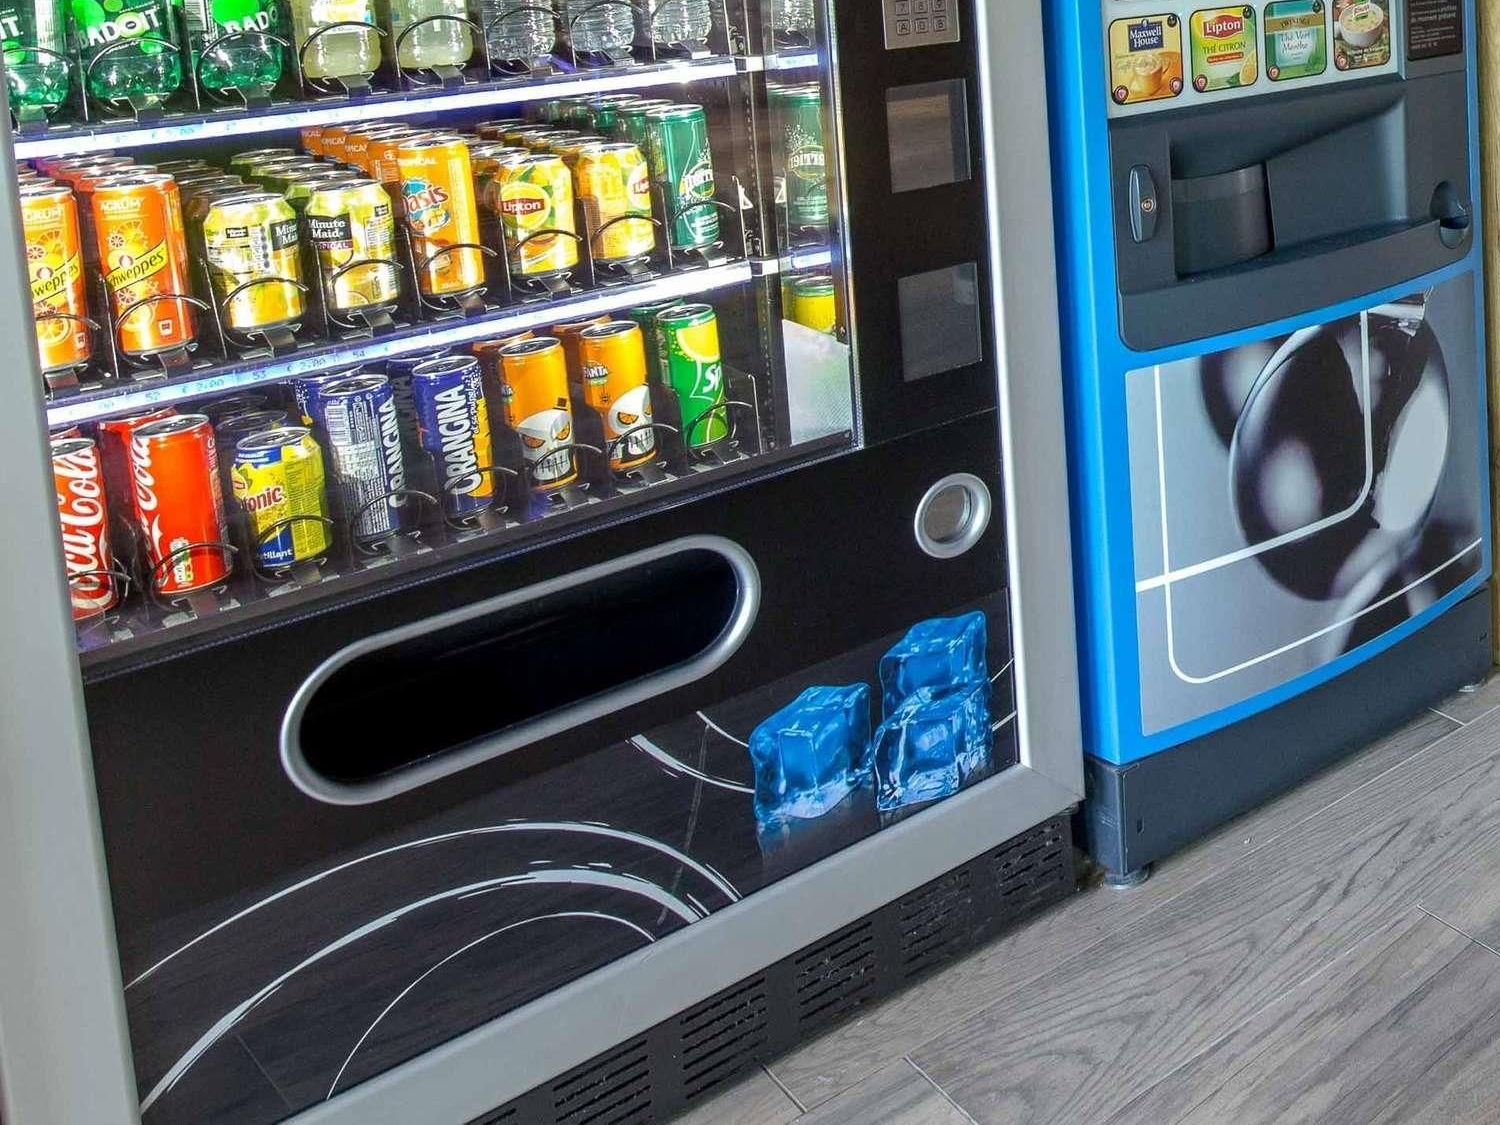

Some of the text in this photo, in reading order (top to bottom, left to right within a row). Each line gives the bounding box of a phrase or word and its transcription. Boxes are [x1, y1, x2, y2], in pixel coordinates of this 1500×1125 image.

[1129, 25, 1162, 39] Maxwell
[1205, 20, 1242, 34] Lipton
[1133, 35, 1160, 48] House
[1202, 41, 1247, 54] THÉ CITRON
[503, 199, 542, 214] Lipton
[312, 228, 339, 239] Maid
[433, 384, 483, 495] ORANGINA
